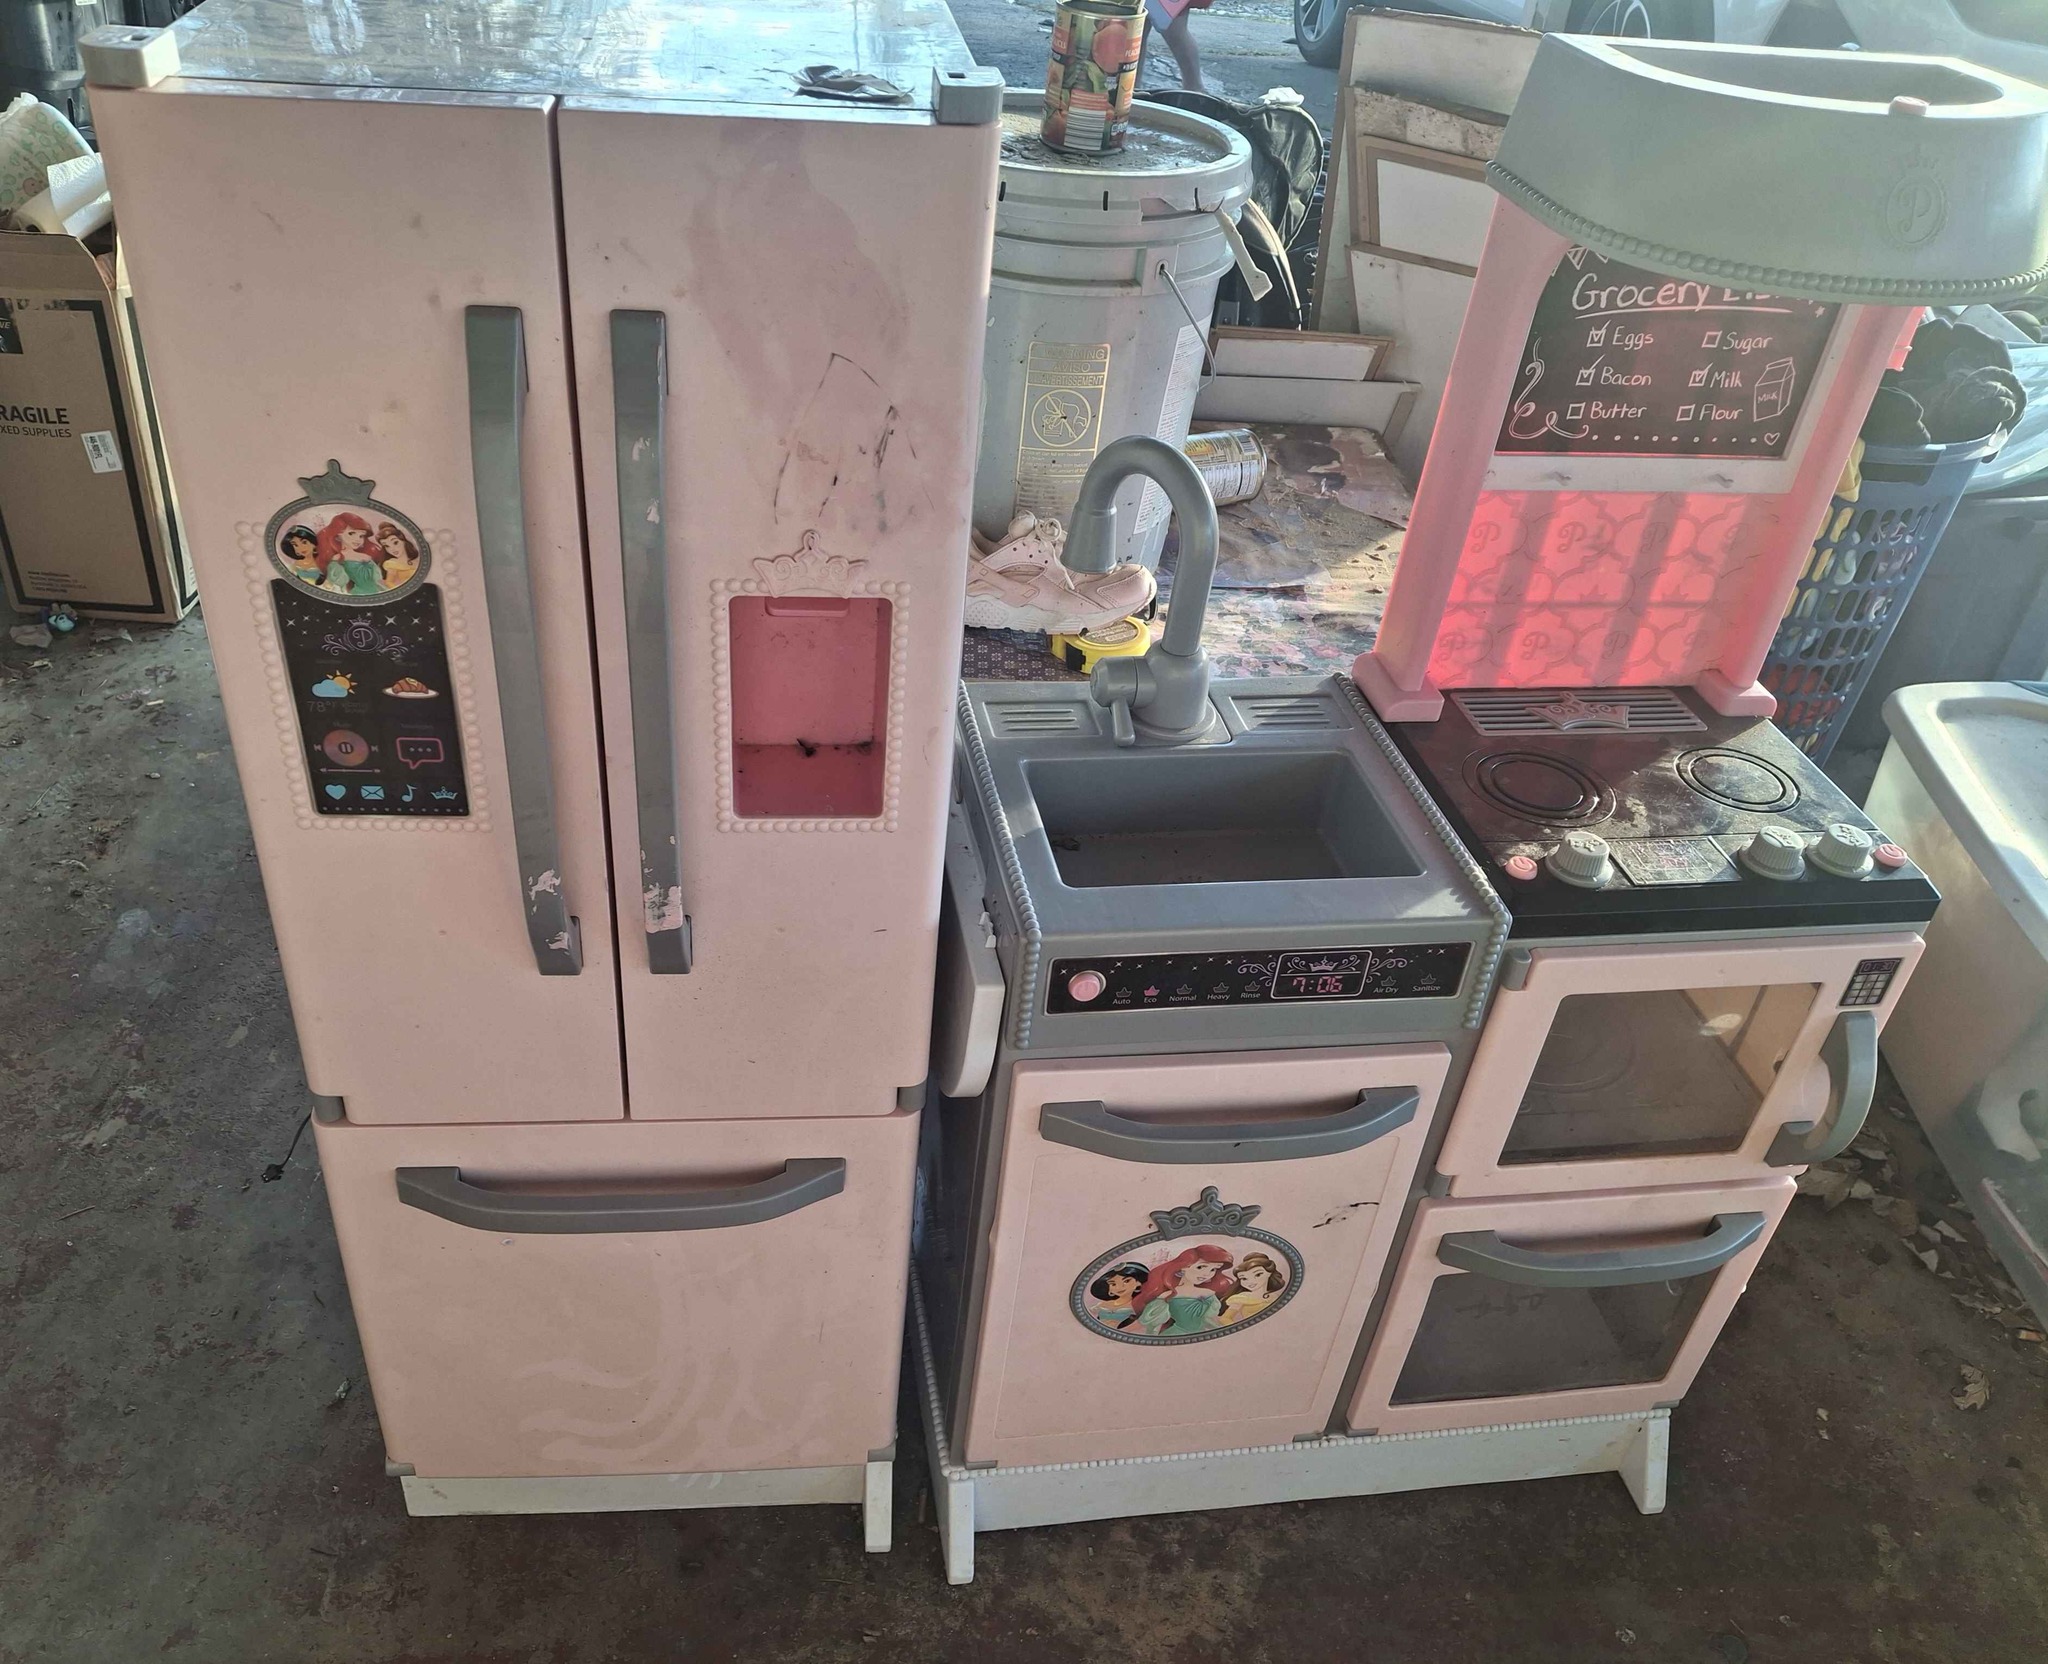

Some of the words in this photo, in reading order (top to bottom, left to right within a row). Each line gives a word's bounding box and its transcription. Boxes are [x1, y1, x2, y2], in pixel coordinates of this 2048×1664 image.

[1572, 273, 1710, 312] Grocery
[1612, 325, 1654, 350] Eggs
[1722, 331, 1773, 355] Sugar
[1600, 366, 1652, 387] Bacon
[1710, 370, 1743, 388] Milk
[1590, 401, 1647, 420] Butter
[1699, 405, 1744, 421] Flour
[22, 426, 72, 438] SUPPLIES
[1292, 975, 1343, 993] 7:06
[1373, 986, 1384, 994] Air
[1385, 985, 1399, 994] Dry
[1169, 994, 1197, 1002] Normal
[1207, 993, 1230, 1001] Heavy
